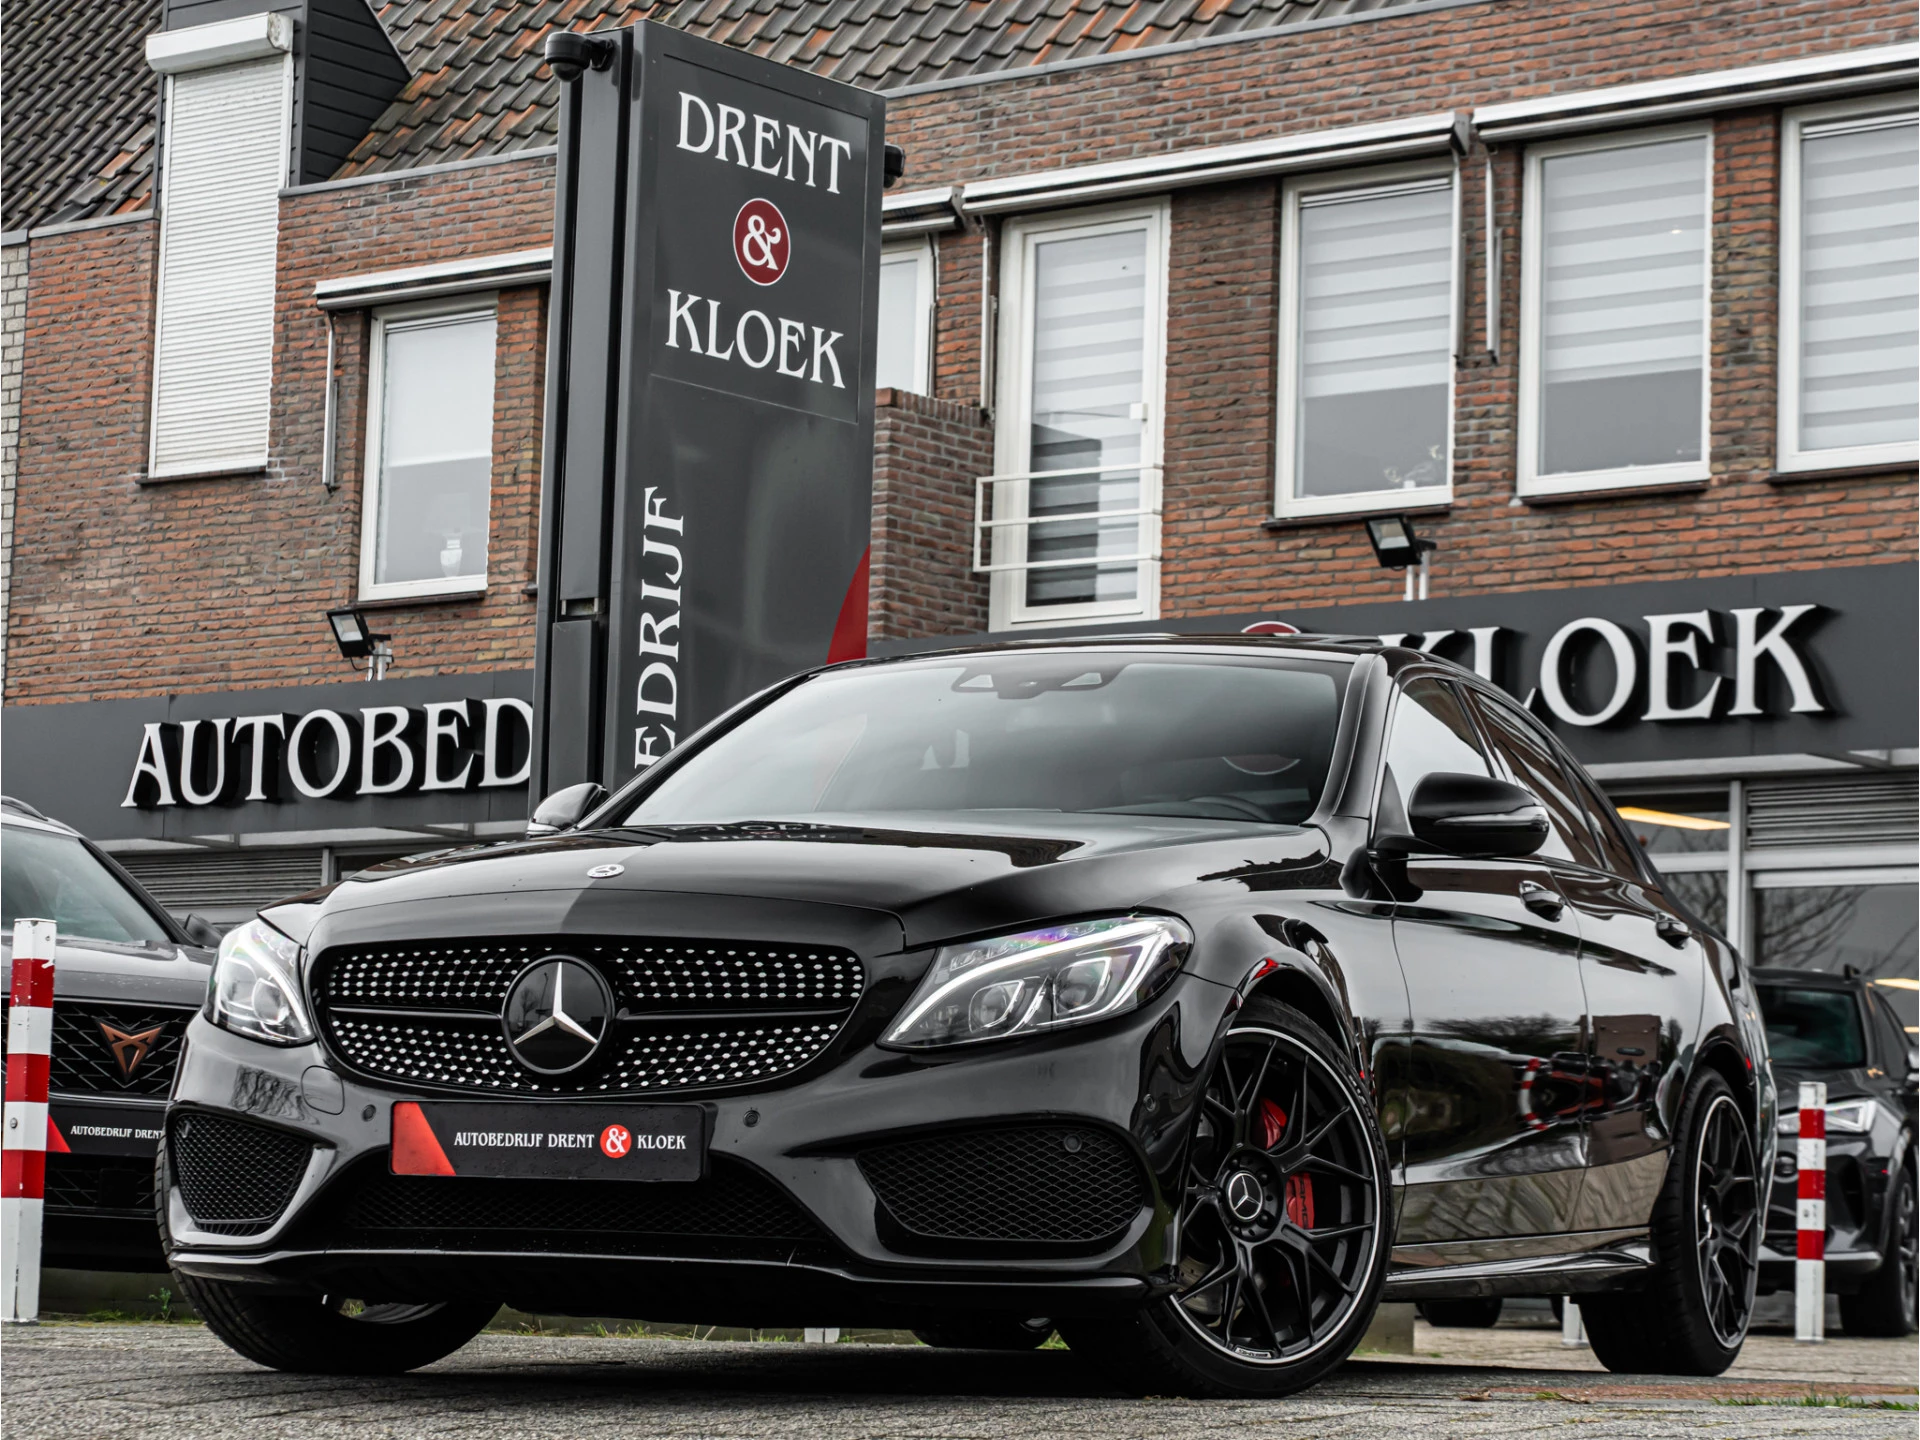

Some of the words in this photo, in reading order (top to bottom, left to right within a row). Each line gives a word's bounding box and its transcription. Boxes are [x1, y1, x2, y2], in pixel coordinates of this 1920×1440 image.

[676, 91, 851, 194] DRENT
[742, 214, 782, 271] &
[665, 288, 846, 389] KLOEK
[1378, 603, 1825, 727] LOEK
[120, 697, 534, 808] AUTOBED
[70, 1125, 133, 1138] AUTOBEDRIJF
[454, 1132, 544, 1148] AUTOBEDRIJF
[548, 1133, 595, 1149] DRENT
[605, 1127, 628, 1153] &
[637, 1134, 686, 1150] KLOEK
